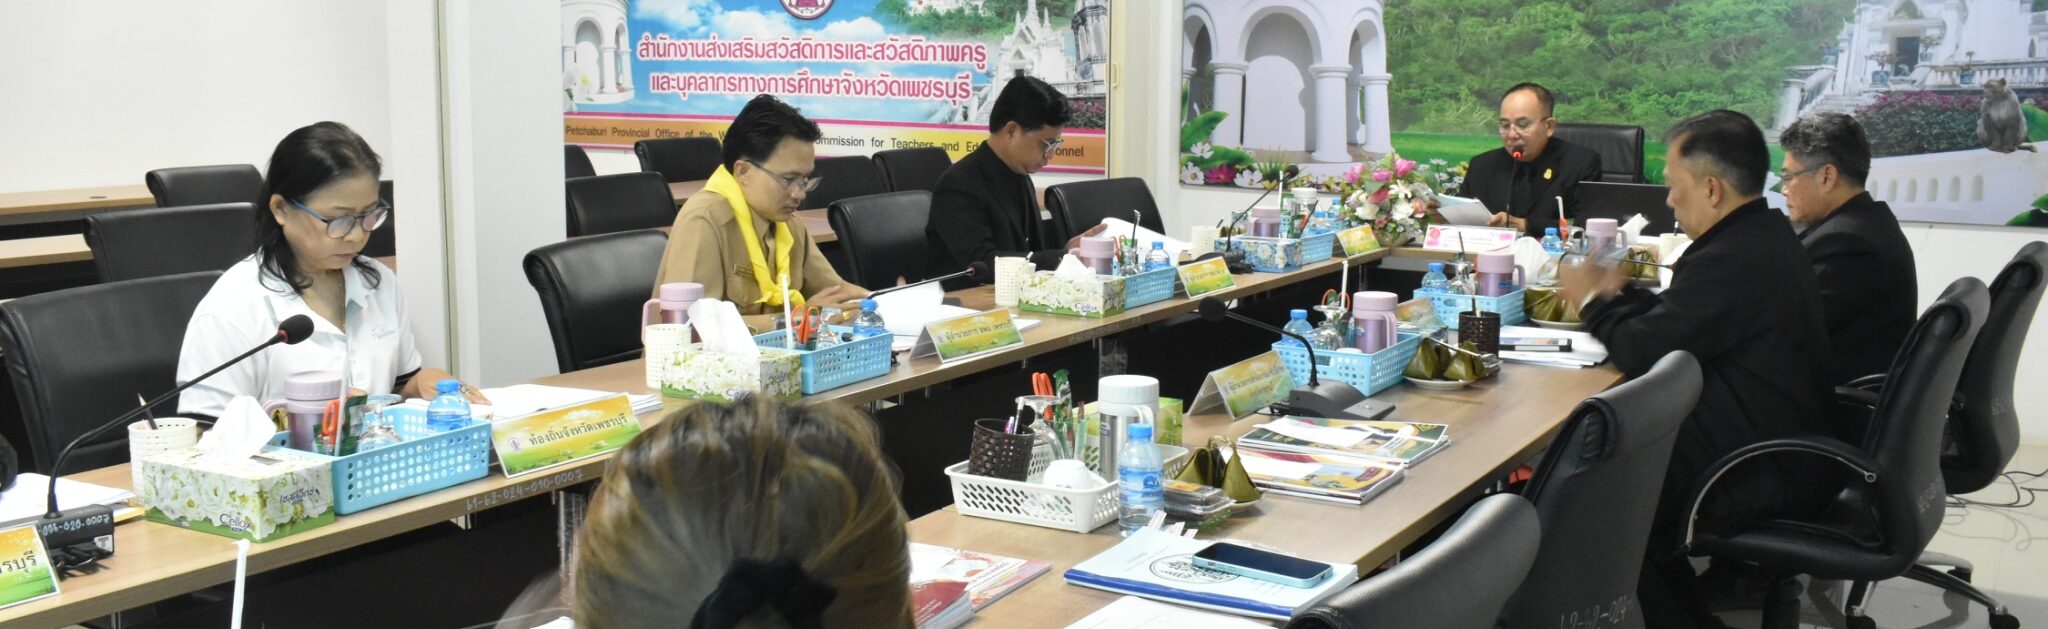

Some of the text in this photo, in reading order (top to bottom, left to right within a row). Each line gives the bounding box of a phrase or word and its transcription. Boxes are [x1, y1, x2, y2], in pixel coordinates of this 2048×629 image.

[638, 35, 986, 70] สำนักงานส่งเสริมสวัสดิการและสวัสดิภาพครู
[651, 70, 972, 106] และบุคลากรทางการศึกษาจังหวัดเพชรบุรี
[565, 125, 608, 137] Petchaburi
[611, 127, 650, 138] Provincial
[655, 128, 680, 138] Office
[871, 136, 885, 148] for
[1055, 146, 1084, 157] onnel
[528, 412, 628, 447] ท้องถิ่นจังหวัดเพชรบุรี
[0, 549, 37, 574] รบุรี
